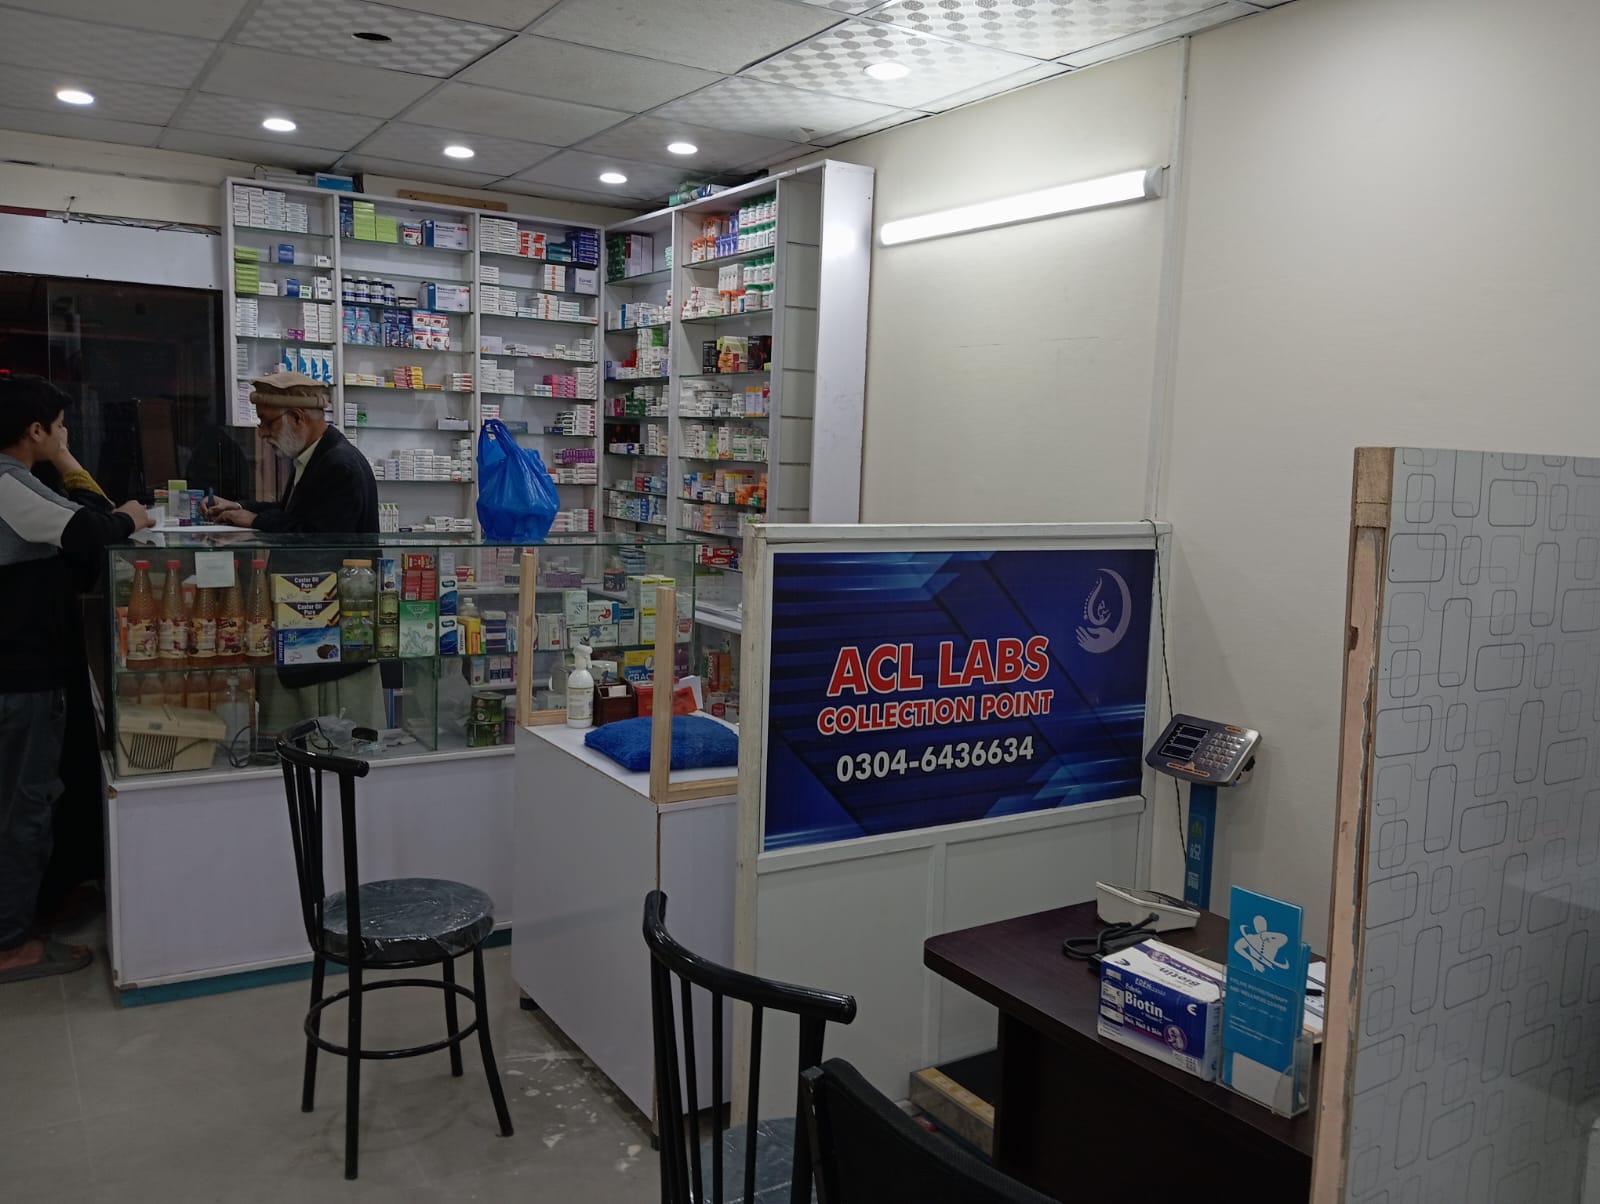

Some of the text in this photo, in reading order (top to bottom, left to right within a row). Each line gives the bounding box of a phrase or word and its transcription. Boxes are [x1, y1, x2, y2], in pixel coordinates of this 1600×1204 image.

[826, 635, 1049, 697] ACL LABS
[817, 689, 1054, 735] COLLECTION POINT
[836, 736, 1034, 783] 0304-6436634
[1125, 991, 1163, 1018] Biotin
